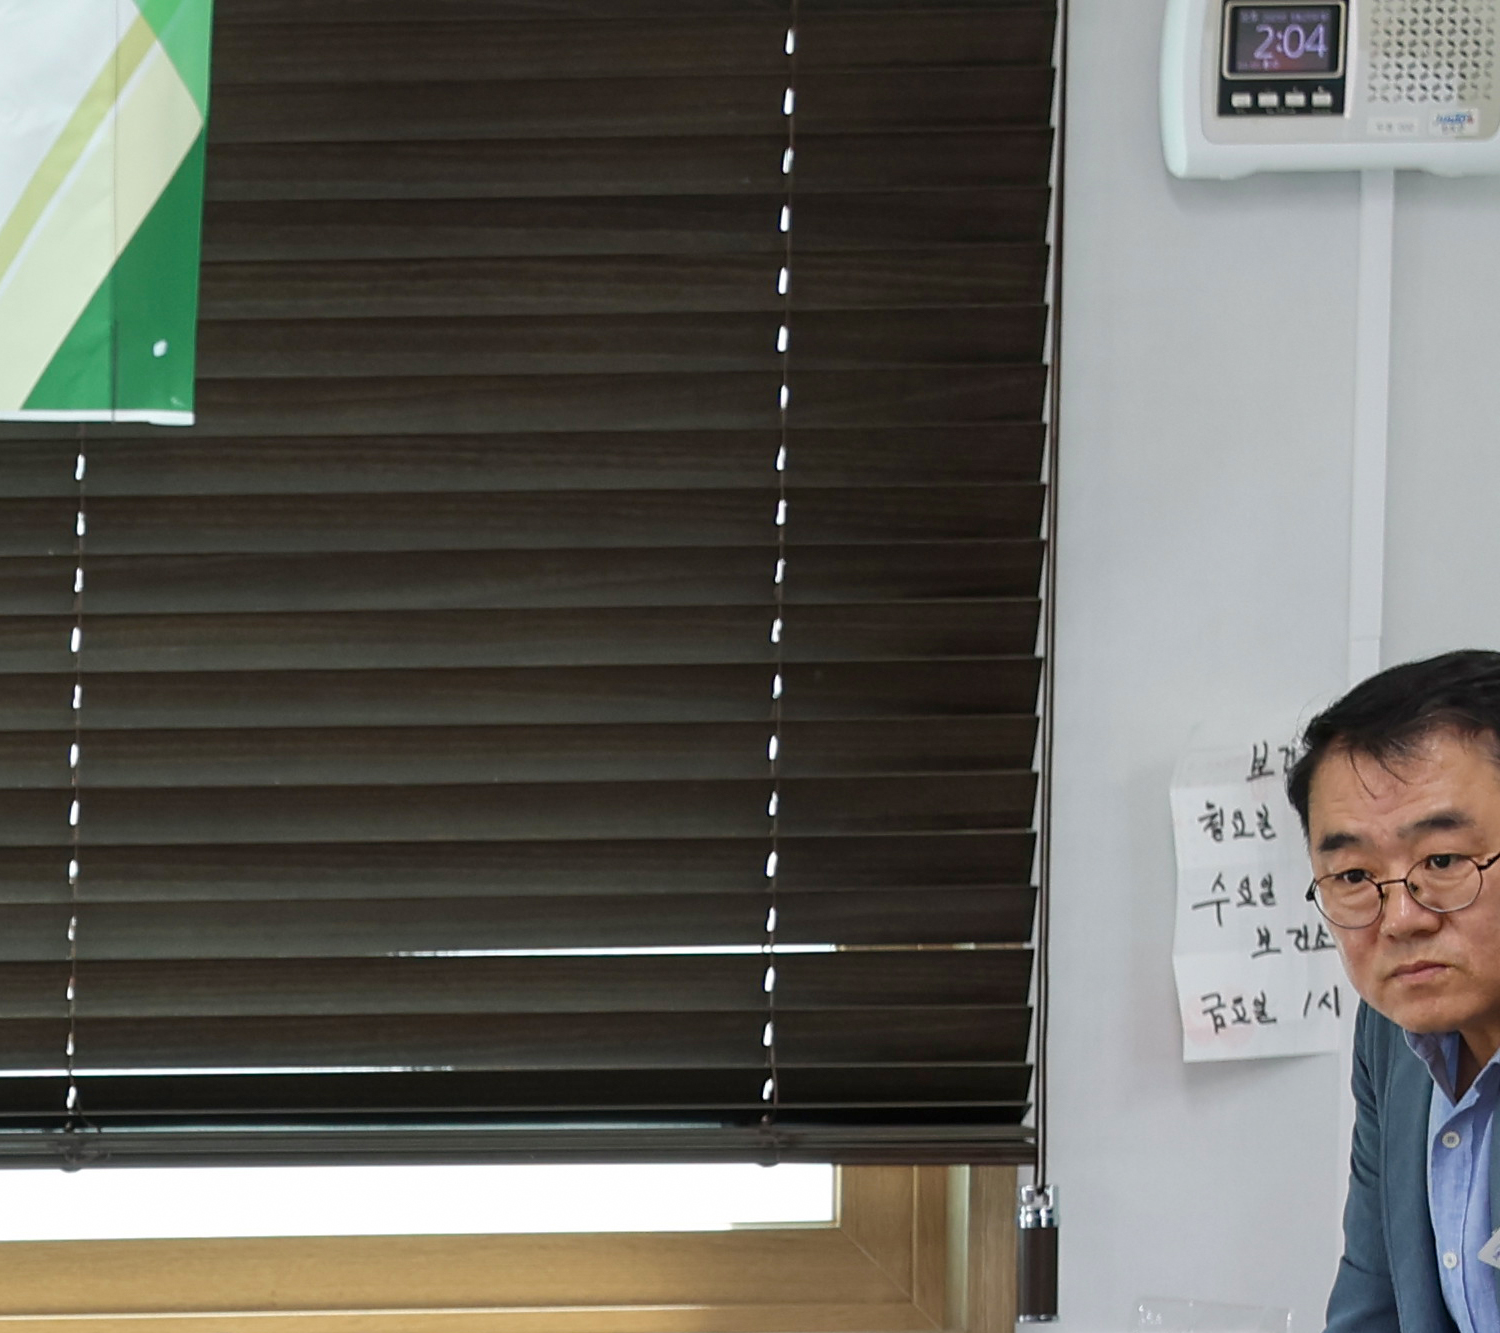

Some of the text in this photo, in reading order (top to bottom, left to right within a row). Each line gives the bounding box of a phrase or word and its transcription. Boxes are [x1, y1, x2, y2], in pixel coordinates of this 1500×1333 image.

[1253, 23, 1328, 59] 2:04
[1191, 872, 1277, 927] 수요일
[1201, 990, 1277, 1034] 금요일
